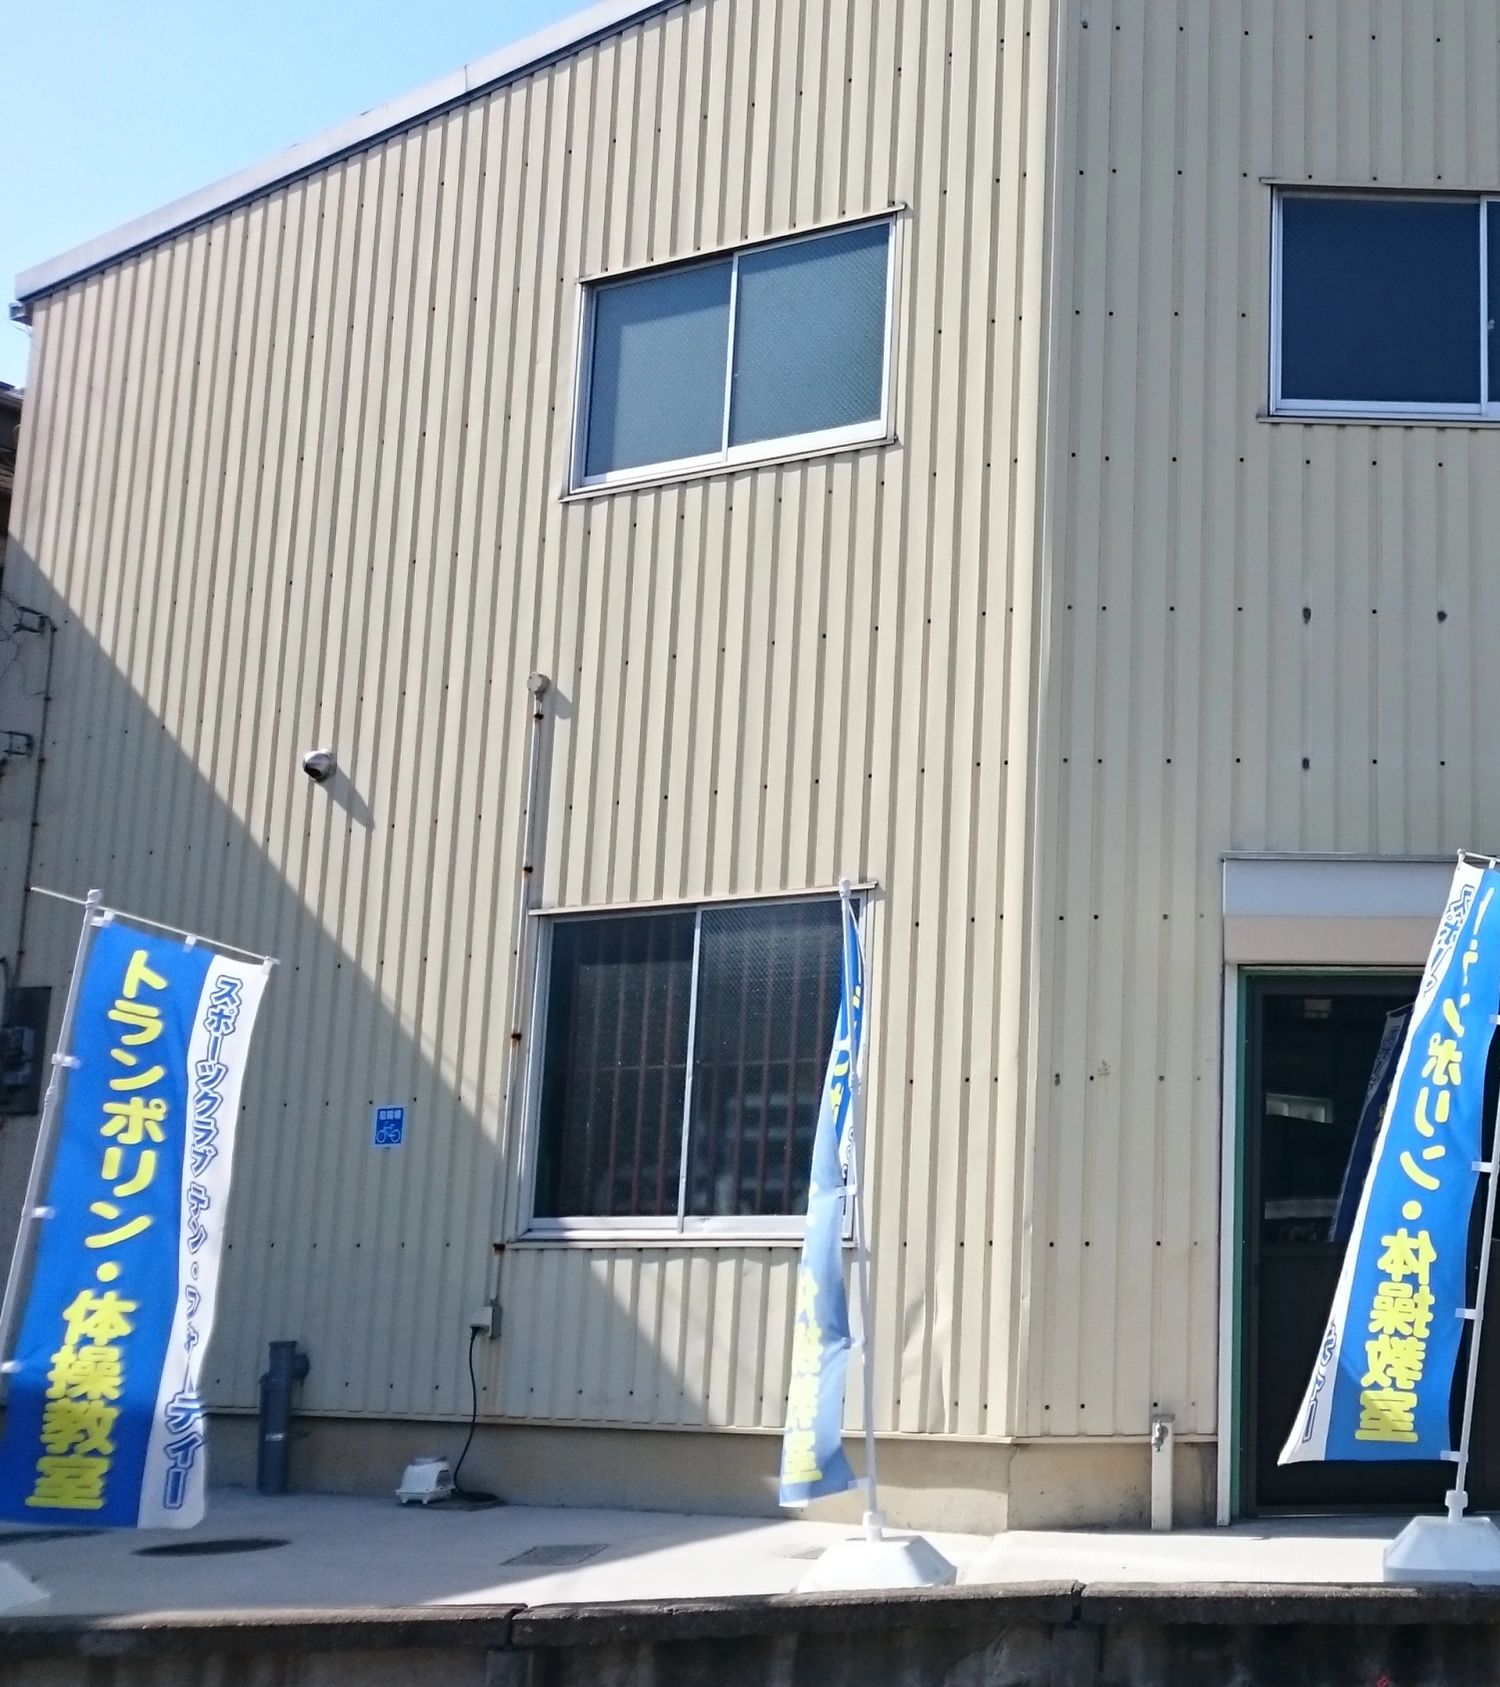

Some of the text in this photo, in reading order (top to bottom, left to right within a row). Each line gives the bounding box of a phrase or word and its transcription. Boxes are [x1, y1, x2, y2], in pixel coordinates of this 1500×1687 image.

[25, 949, 167, 1511] トランポリン・体操教室
[190, 974, 243, 1178] スポーツクラブ
